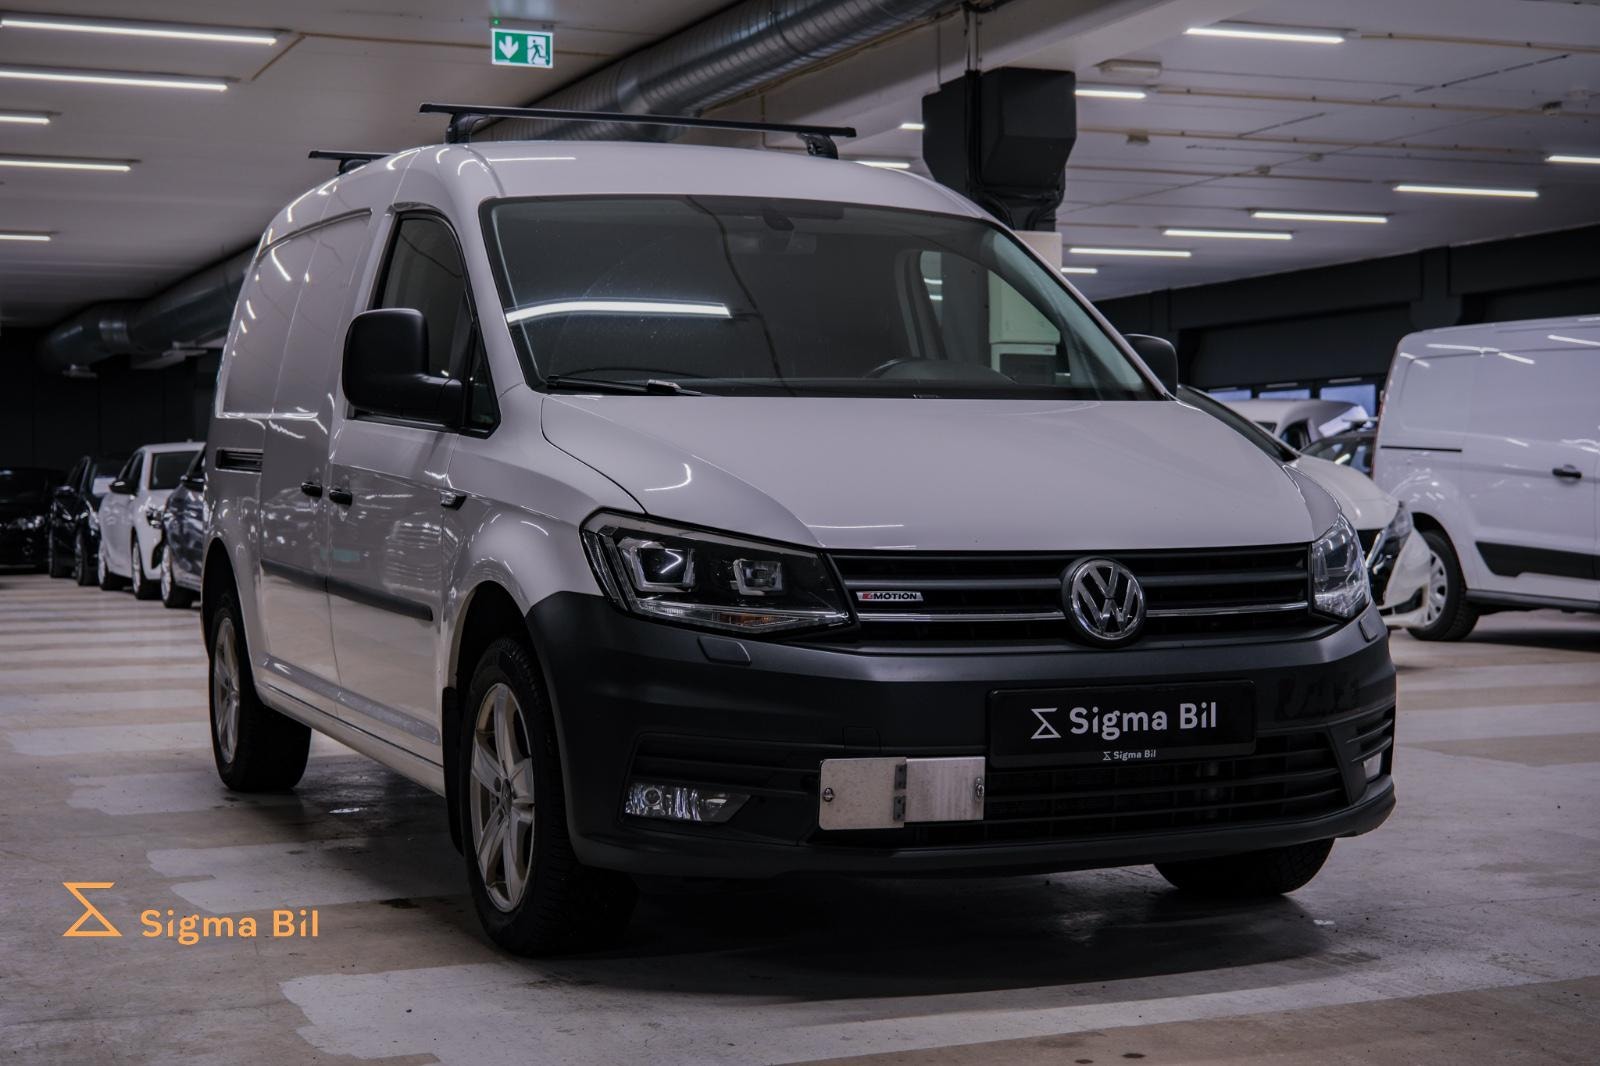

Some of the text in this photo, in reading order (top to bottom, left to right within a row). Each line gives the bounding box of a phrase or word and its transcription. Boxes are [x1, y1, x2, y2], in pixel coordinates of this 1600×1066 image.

[1069, 702, 1217, 741] Sigma Bil
[1113, 749, 1156, 761] Sigma Bil
